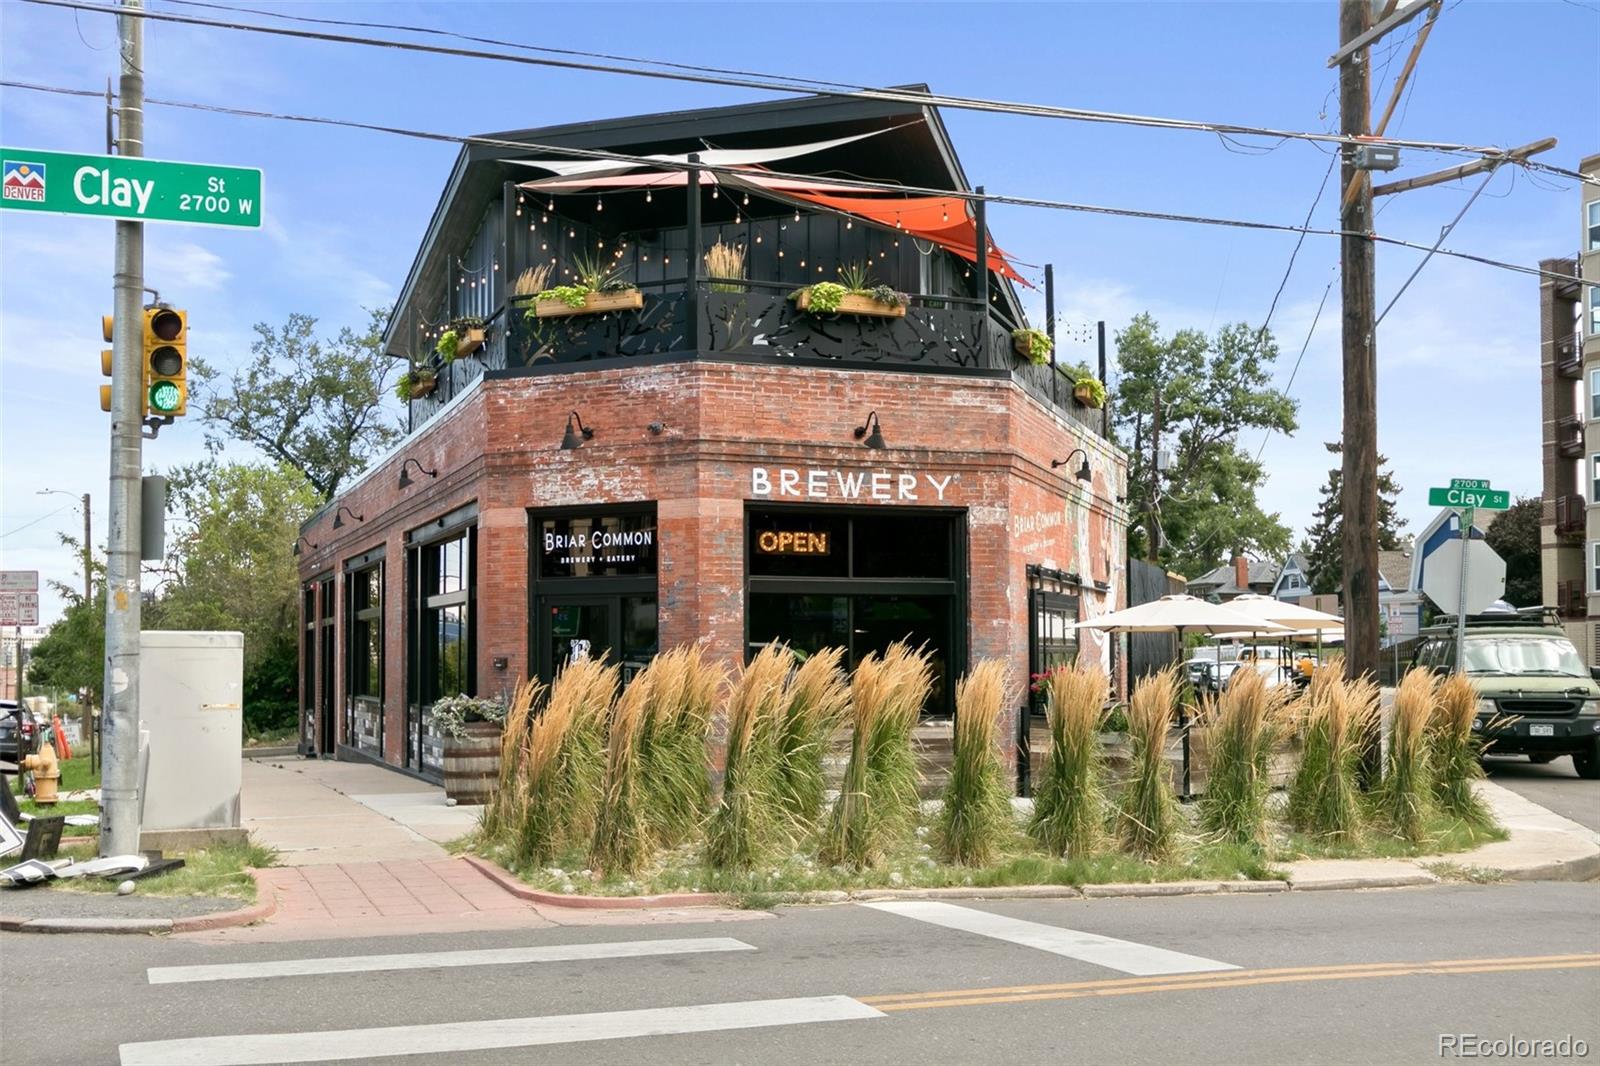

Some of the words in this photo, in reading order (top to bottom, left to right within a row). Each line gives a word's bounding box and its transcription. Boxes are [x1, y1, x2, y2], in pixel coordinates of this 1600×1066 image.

[4, 186, 44, 200] DENVER
[73, 166, 154, 214] Clay
[207, 176, 225, 193] St
[179, 194, 230, 213] 2700
[238, 199, 253, 215] W
[752, 467, 951, 501] BREWERY
[1454, 480, 1478, 488] 2700
[1481, 481, 1489, 489] W
[1447, 489, 1486, 508] Clay
[1493, 495, 1503, 503] St
[545, 532, 586, 551] BRIAR
[591, 531, 652, 549] COMMON
[759, 531, 826, 552] OPEN
[560, 556, 595, 564] BREWERY
